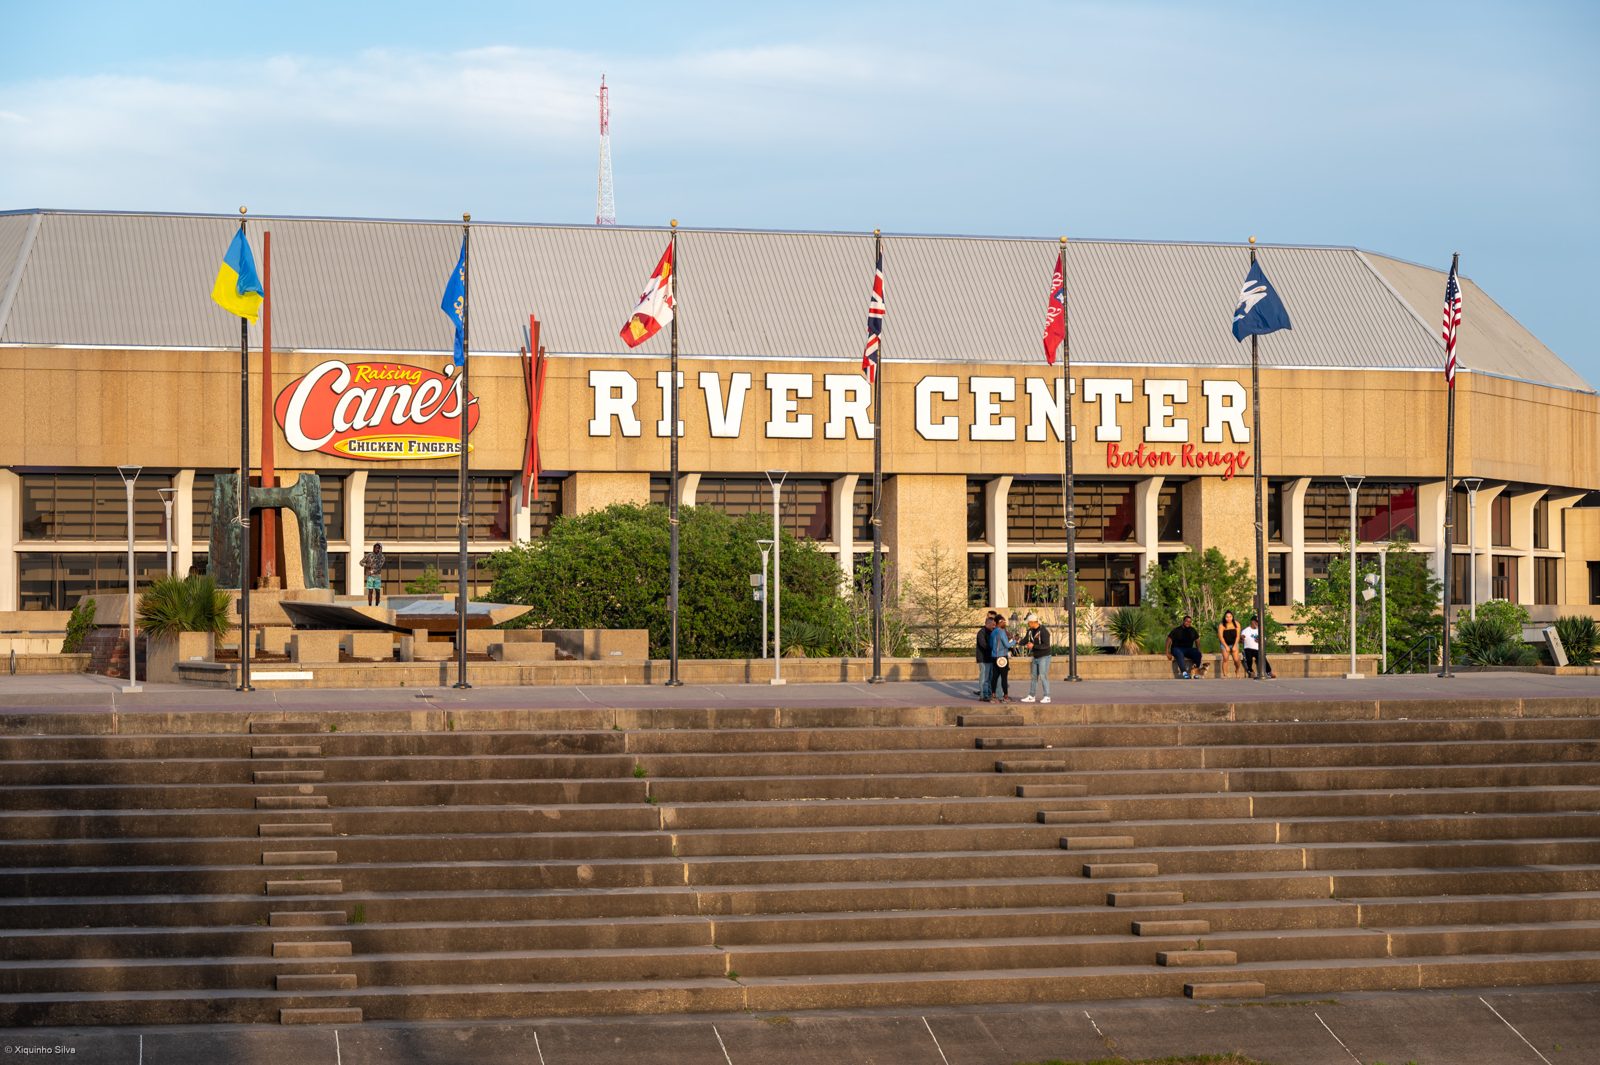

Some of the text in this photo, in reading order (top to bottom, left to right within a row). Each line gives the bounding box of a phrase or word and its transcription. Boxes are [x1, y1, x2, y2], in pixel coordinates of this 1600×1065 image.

[354, 365, 423, 385] Raising
[284, 360, 479, 452] Cane's
[588, 369, 1251, 444] RIVER CENTER
[348, 439, 461, 453] CHICKEN FINGERS
[1106, 442, 1251, 479] Baton Rouge
